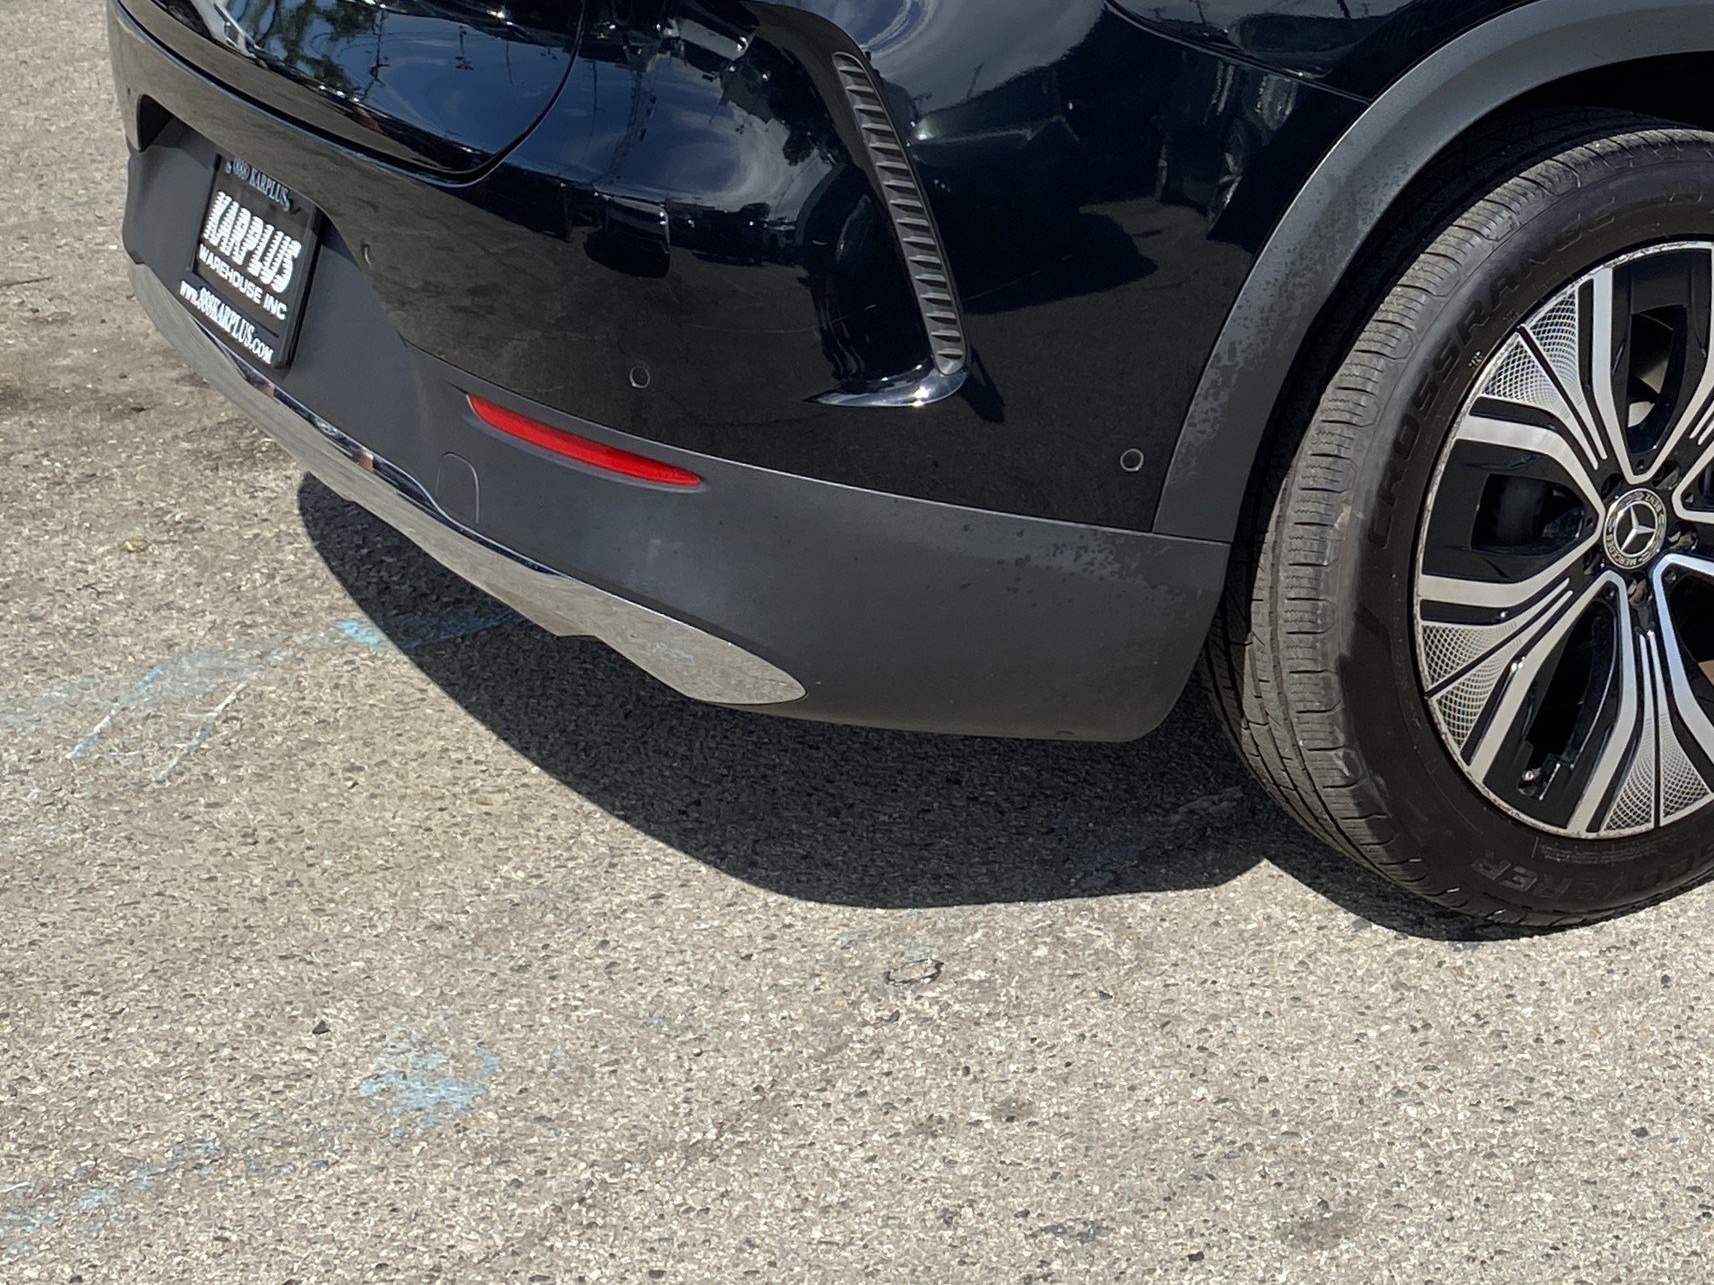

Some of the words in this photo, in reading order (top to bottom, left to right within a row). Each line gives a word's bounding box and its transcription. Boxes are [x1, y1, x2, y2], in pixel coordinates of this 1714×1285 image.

[249, 167, 291, 208] KARPLUS
[203, 191, 302, 293] KARPLUS
[199, 243, 263, 305] WAREHOUSE
[263, 291, 288, 321] INC
